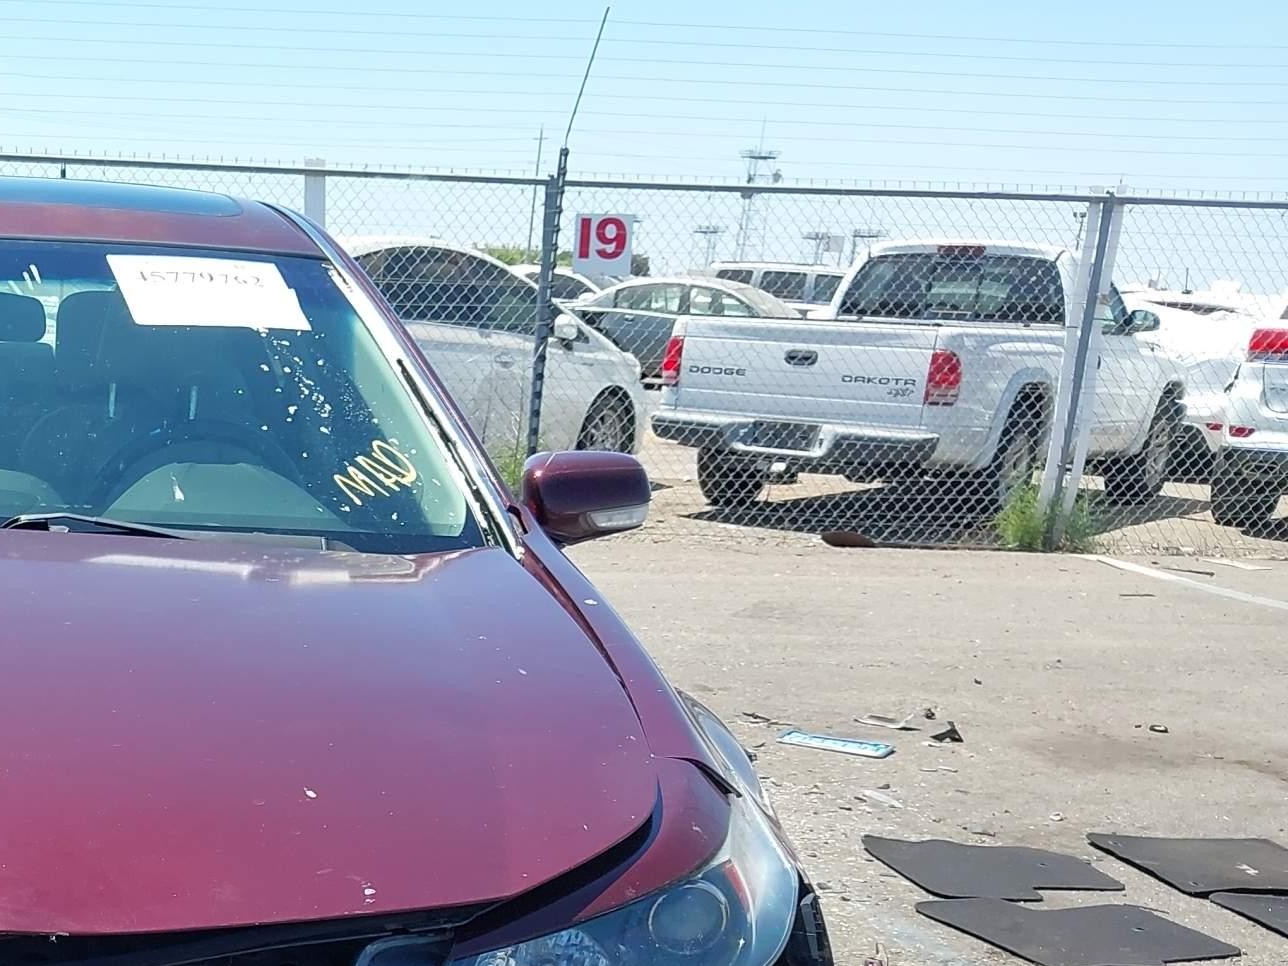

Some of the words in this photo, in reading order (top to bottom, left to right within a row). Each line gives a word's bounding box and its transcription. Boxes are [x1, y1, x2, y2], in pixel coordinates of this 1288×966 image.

[578, 217, 627, 260] 19
[688, 365, 747, 377] DODGE
[841, 375, 917, 387] DAKOTA
